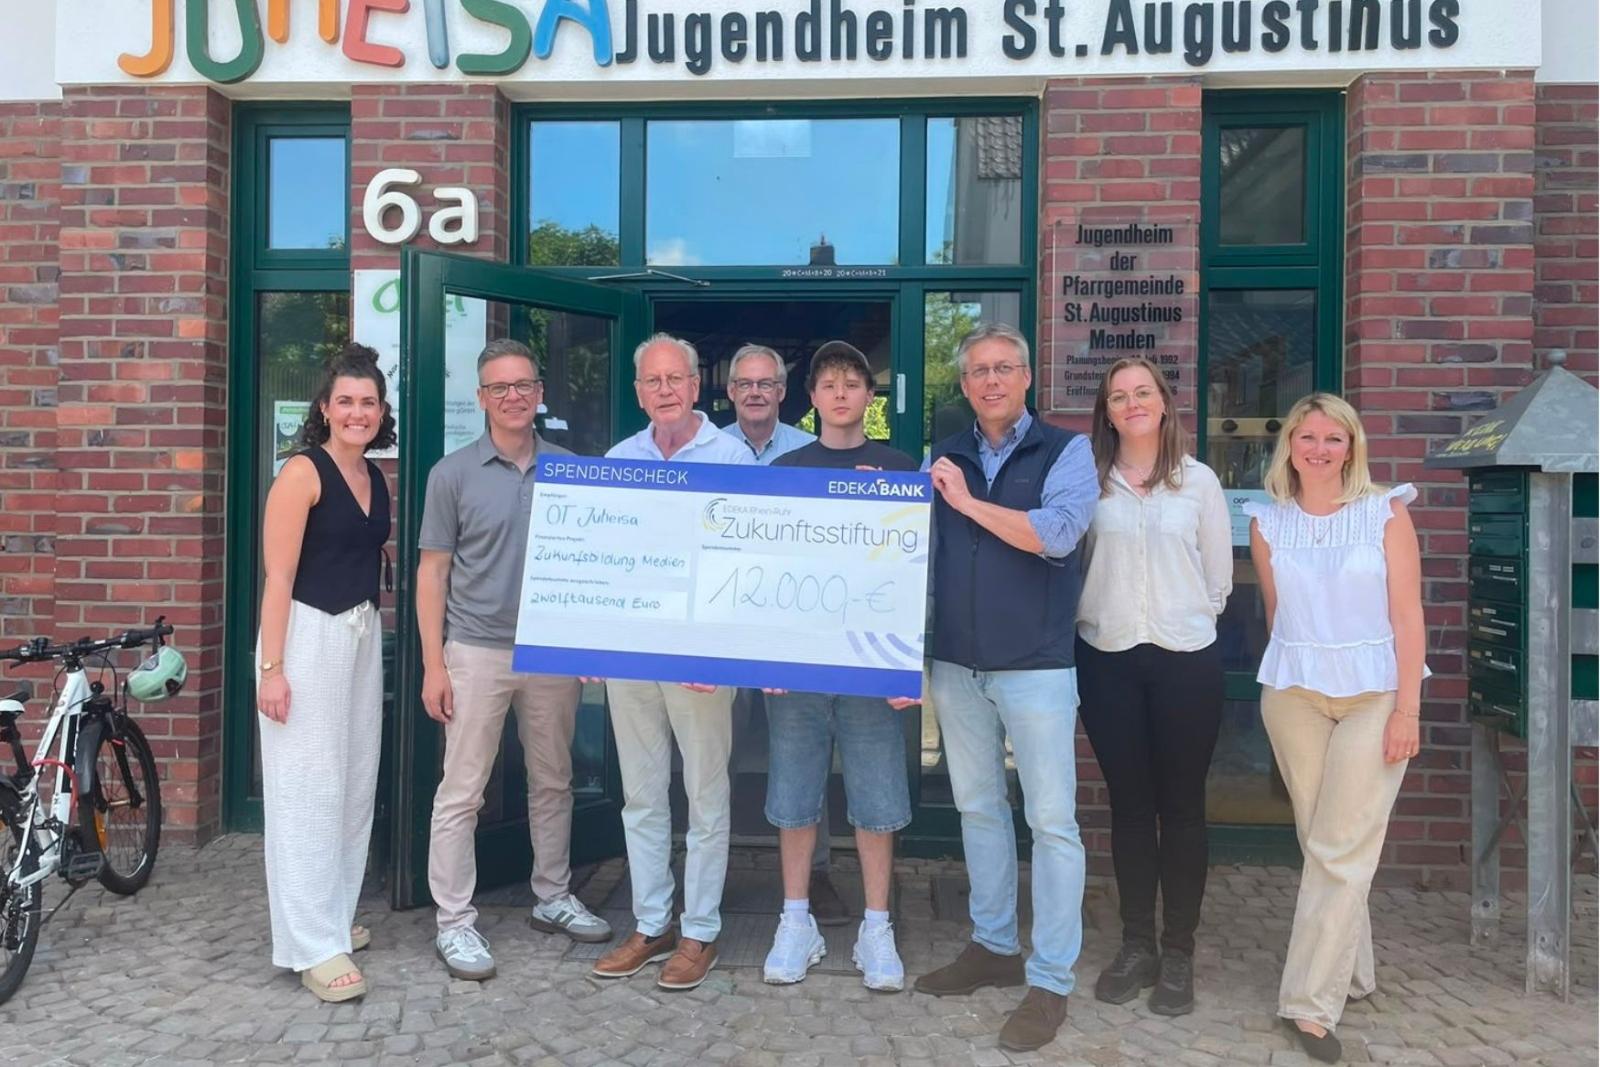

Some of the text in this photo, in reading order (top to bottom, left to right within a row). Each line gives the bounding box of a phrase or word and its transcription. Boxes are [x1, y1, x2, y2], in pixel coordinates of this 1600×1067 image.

[616, 0, 968, 75] Jugendheim
[362, 168, 479, 244] 6a
[1075, 224, 1173, 247] Jugendheim
[1110, 251, 1137, 271] der
[1063, 275, 1184, 298] Pfarrgemeinde
[1090, 329, 1155, 350] Menden
[544, 462, 689, 485] SPENDENSCHECK
[546, 504, 577, 525] OT
[721, 517, 918, 553] Zukunftsstiftung
[642, 555, 685, 568] Medien
[632, 598, 661, 609] Euro
